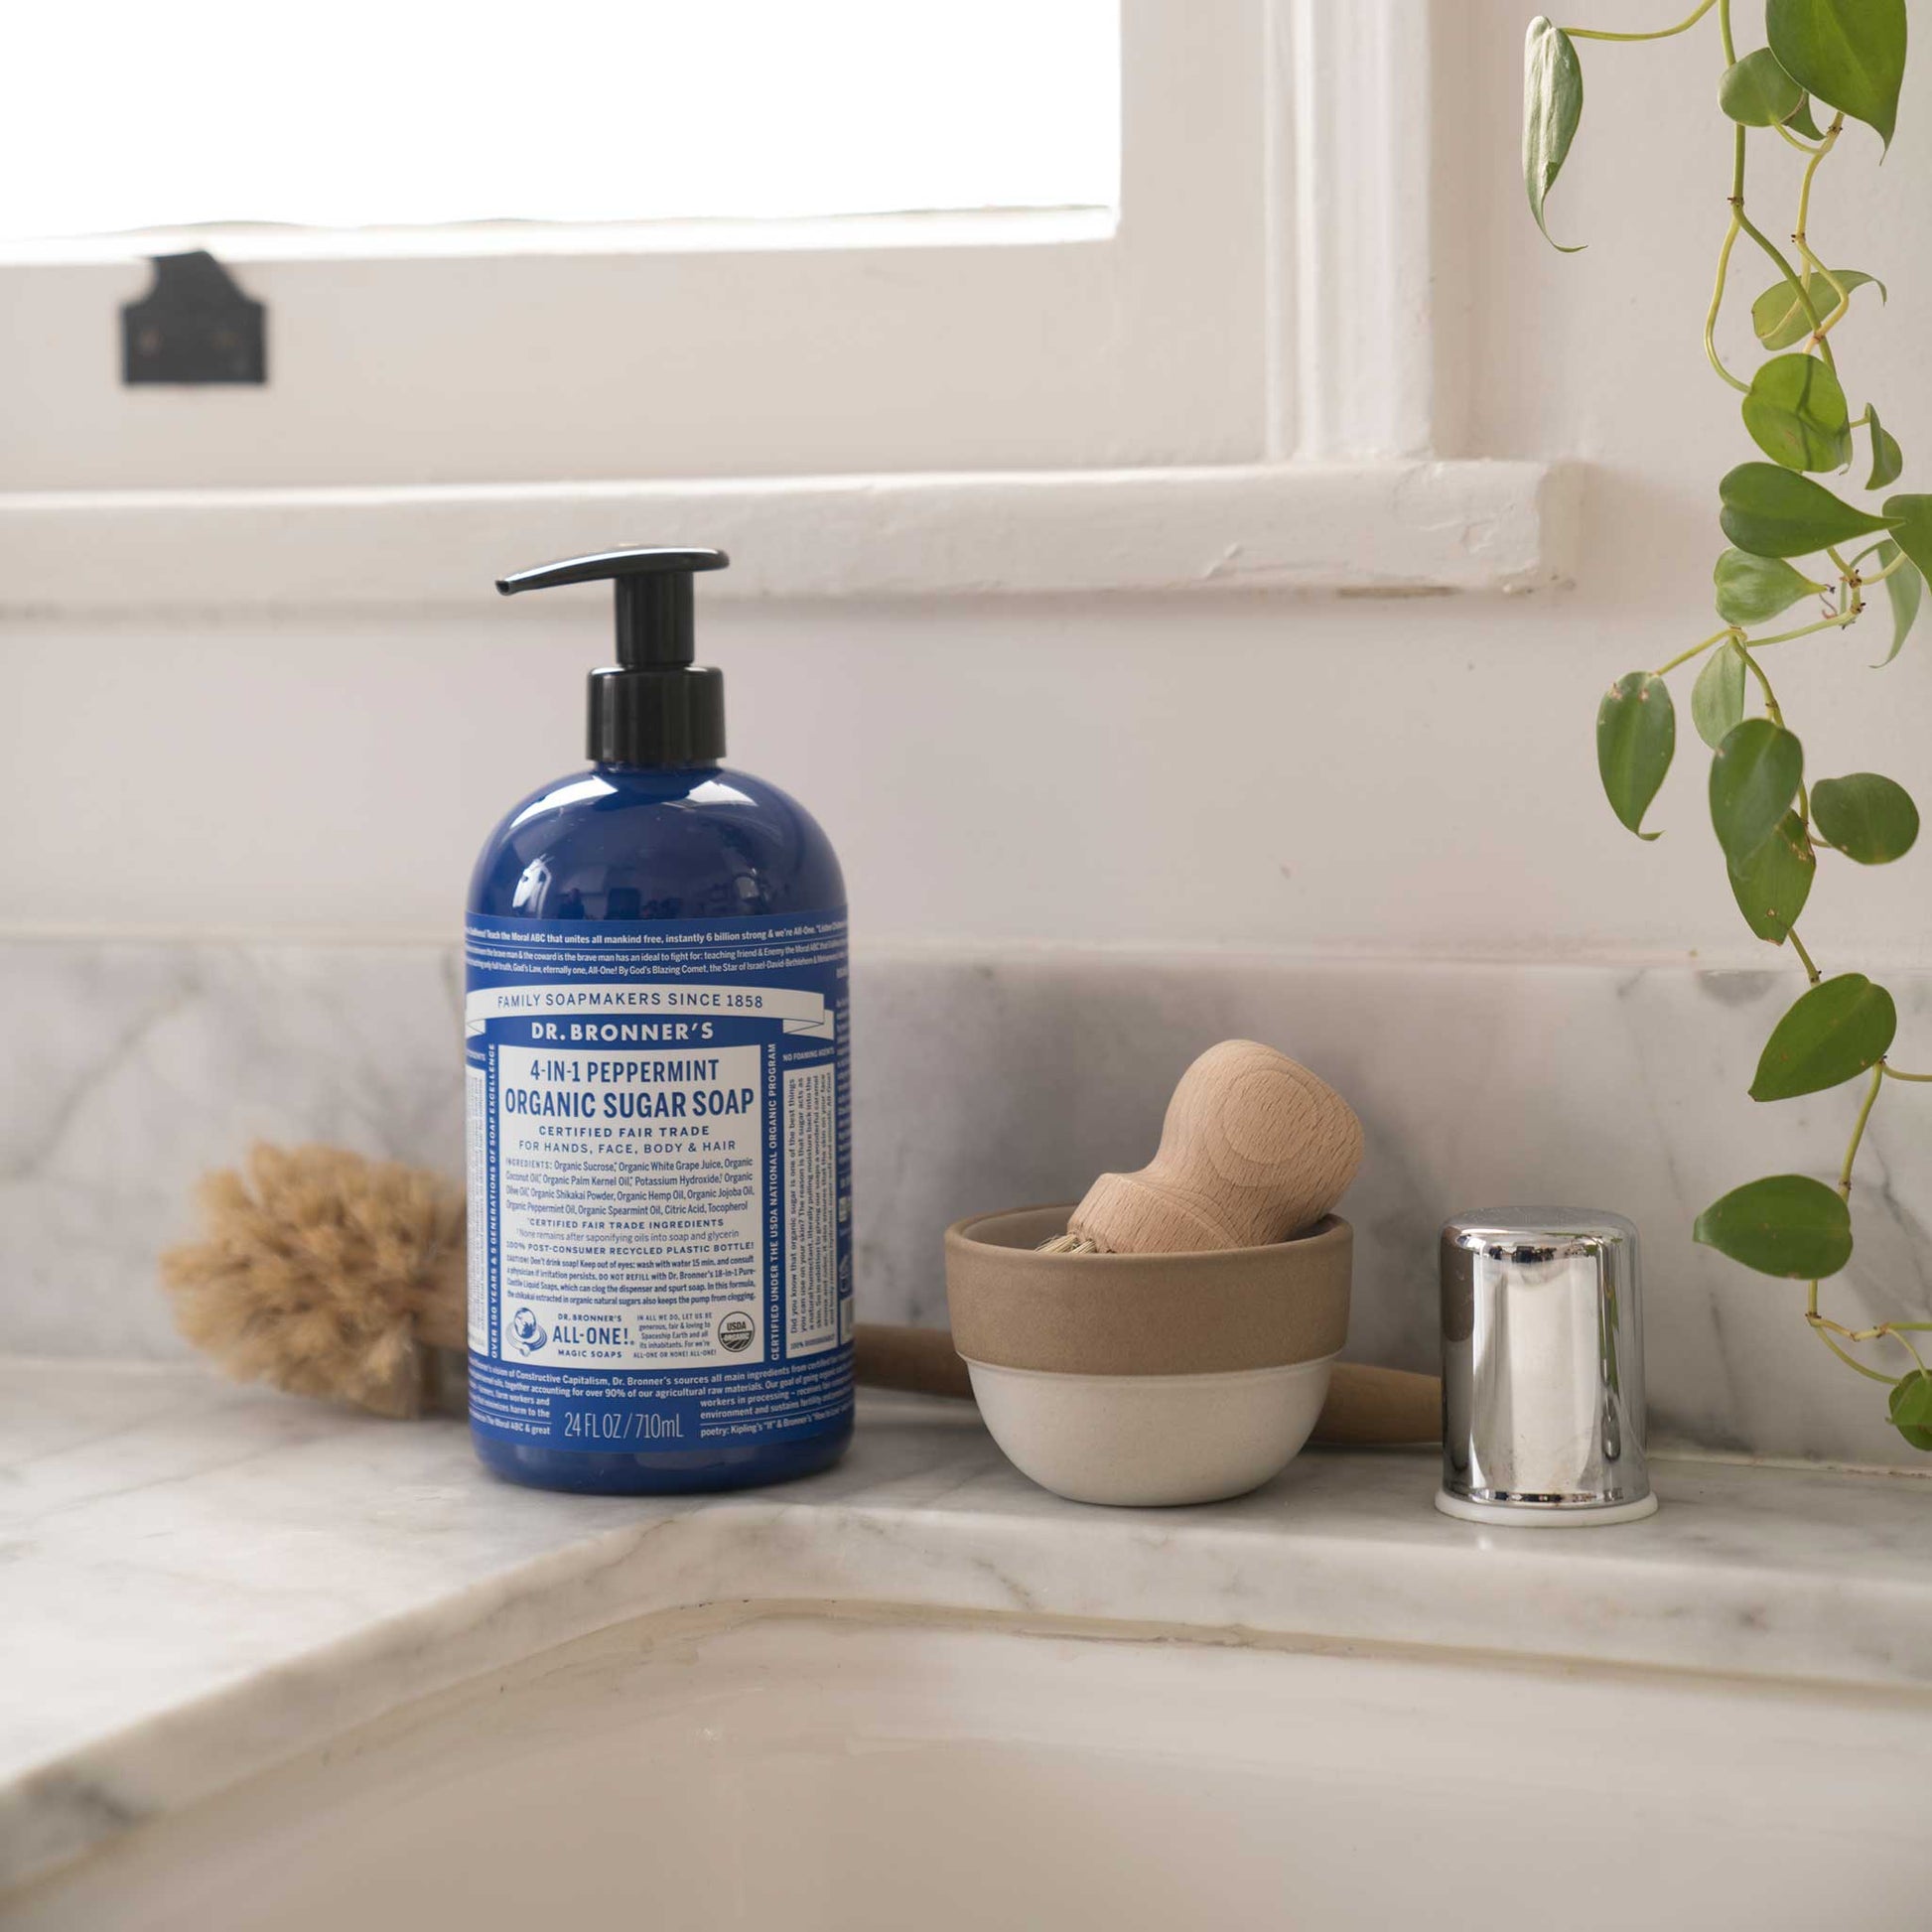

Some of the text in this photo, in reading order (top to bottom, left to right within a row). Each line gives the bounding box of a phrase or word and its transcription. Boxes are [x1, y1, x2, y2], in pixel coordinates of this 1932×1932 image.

[531, 928, 773, 945] ABC that unites all mankind free, instantly 6 billion strong &
[557, 953, 563, 962] is
[565, 953, 576, 962] the
[577, 953, 597, 962] brave
[616, 953, 629, 962] has
[641, 953, 660, 962] ideal
[661, 953, 669, 962] to
[670, 952, 689, 963] fight
[704, 950, 736, 961] teaching
[737, 948, 757, 959] friend
[543, 965, 571, 976] eternally
[620, 966, 628, 977] By
[629, 966, 651, 975] God's
[652, 965, 680, 977] Blazing
[709, 963, 721, 973] the
[722, 962, 738, 972] Star
[739, 962, 747, 971] of
[497, 993, 763, 1009] FAMILY SOAPMAKERS SINCE 1858
[531, 1022, 714, 1041] DR. BRONNER'S
[530, 1059, 719, 1083] 4-IN-1 PEPPERMINT
[767, 1043, 776, 1096] PROGRAM
[505, 1088, 755, 1119] ORGANIC SUGAR SOAP
[539, 1126, 710, 1138] CERTIFIED FAIR TRADE
[768, 1100, 777, 1149] ORGANIC
[489, 1149, 496, 1163] OF
[518, 1141, 736, 1155] FOR HANDS, FACE, BODY & HAIR
[554, 1161, 582, 1172] Organic
[619, 1162, 649, 1173] Organic
[650, 1161, 674, 1172] White
[675, 1161, 699, 1173] Grape
[700, 1159, 724, 1171] Juice,
[724, 1157, 753, 1170] Organic
[543, 1172, 753, 1186] Organic Palm Kernel Potassium Organic
[769, 1152, 778, 1206] NATIONAL
[556, 1186, 742, 1202] Shikakai Powder, Organic Hemp Oil, Organic Jojoba
[527, 1201, 748, 1217] Peppermint Organic Spearmint Oil, Citric Acid, Tocopherol
[582, 1218, 724, 1230] FAIR TRADE INGREDIENTS
[769, 1208, 778, 1238] USDA
[566, 1229, 739, 1244] after saponifying oils into soap and glycerin
[528, 1241, 755, 1255] POST-CONSUMER RECYCLED PLASTIC BOTTLE!
[769, 1241, 778, 1262] THE
[580, 1260, 596, 1270] Keep
[636, 1260, 654, 1269] wash
[655, 1259, 671, 1269] with
[717, 1257, 729, 1266] and
[730, 1255, 754, 1265] consult
[651, 1272, 667, 1281] with
[572, 1313, 622, 1322] BRONNER'S
[727, 1321, 747, 1331] USDA
[770, 1305, 779, 1360] CERTIFIED
[552, 1325, 627, 1345] ALL-ONE!
[591, 1349, 622, 1358] SOAPS
[516, 1368, 790, 1388] Constructive Capitalism, Dr. Bronner's sources all main ingredients
[531, 1385, 571, 1398] accounting
[572, 1387, 584, 1397] for
[586, 1389, 603, 1398] over
[605, 1388, 625, 1398] 90%
[627, 1388, 637, 1398] of
[655, 1386, 706, 1400] agricultural
[725, 1383, 763, 1394] materials.
[700, 1396, 736, 1408] workers
[738, 1394, 746, 1404] in
[748, 1390, 789, 1405] processing
[700, 1404, 769, 1420] environment and
[531, 1425, 550, 1436] great
[565, 1412, 581, 1438] 24
[585, 1413, 601, 1439] FL
[603, 1413, 621, 1439] OZ
[636, 1412, 685, 1439] 710mL
[701, 1423, 762, 1439] poetry: Kipling's
